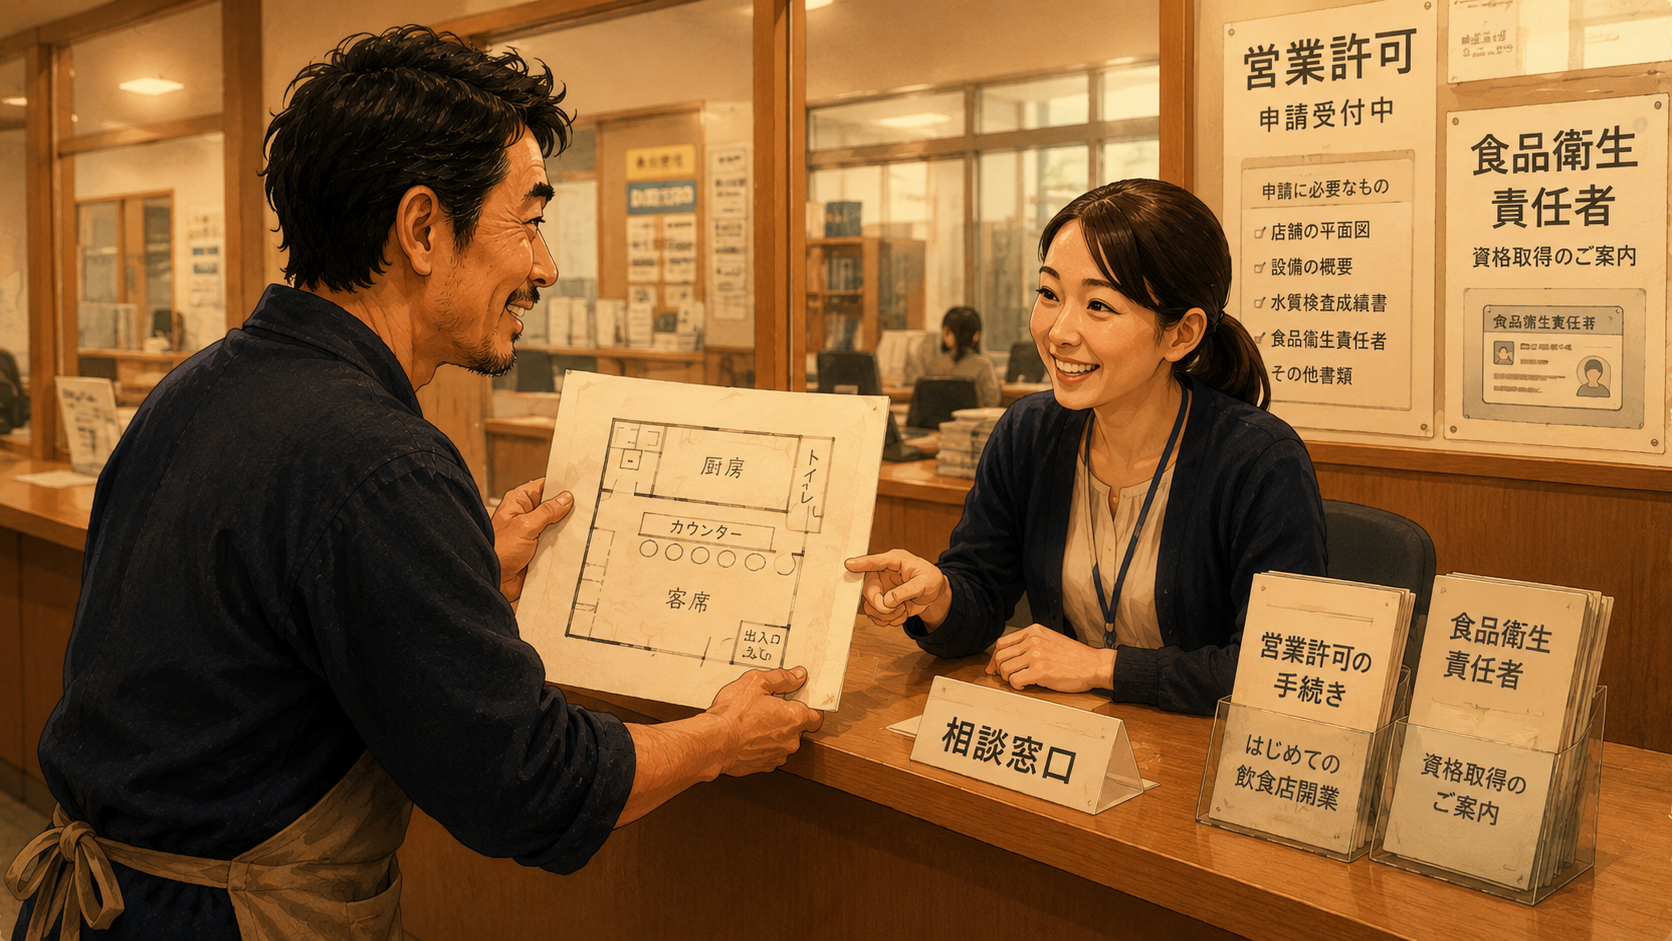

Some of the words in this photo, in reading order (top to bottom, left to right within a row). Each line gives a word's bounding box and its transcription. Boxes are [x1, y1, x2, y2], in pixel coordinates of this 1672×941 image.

[1244, 28, 1416, 90] 営業許可
[1260, 97, 1392, 132] 申請受付中
[1471, 125, 1638, 176] 食品衛生
[1263, 179, 1388, 200] 申請に必要なもの
[1492, 184, 1615, 229] 責任者
[1272, 221, 1369, 240] 店舗の平面図
[1272, 258, 1352, 276] 設備の概要
[1473, 245, 1635, 267] 資格取得のご案内
[1271, 293, 1386, 312] 水質検査成績書
[1272, 366, 1352, 385] その他書類
[701, 457, 744, 478] 厨房
[670, 520, 742, 540] カウンター
[666, 587, 710, 613] 客席
[744, 629, 781, 645] 出入口
[1449, 612, 1553, 654] 食品衛生
[1260, 631, 1372, 673] 営業許可の
[1443, 650, 1524, 690] 責任者
[1274, 672, 1346, 708] 手続き
[942, 717, 1077, 785] 相談窓口
[1245, 734, 1340, 774] はじめての
[1235, 764, 1340, 811] 飲食店開業
[1421, 753, 1527, 794] 資格取得の
[1433, 791, 1500, 826] ご案内
